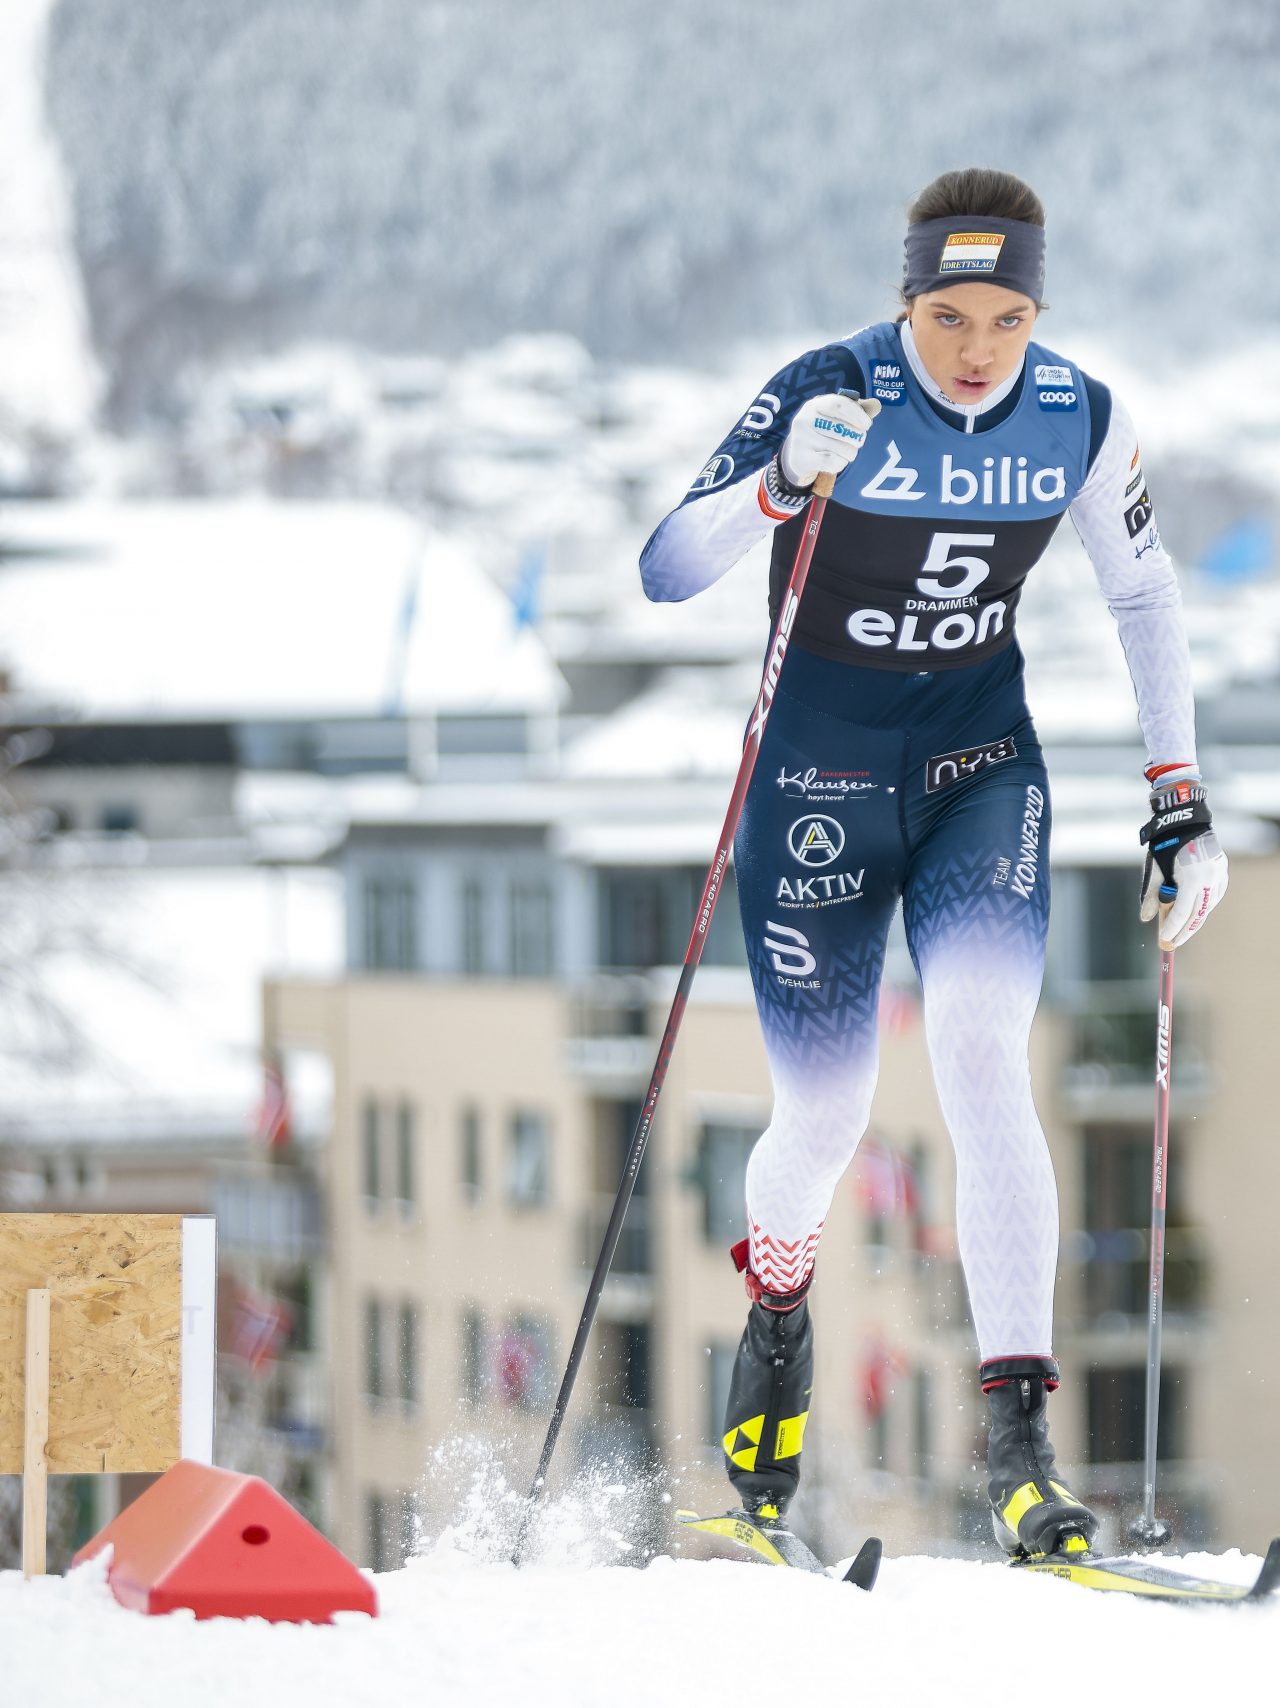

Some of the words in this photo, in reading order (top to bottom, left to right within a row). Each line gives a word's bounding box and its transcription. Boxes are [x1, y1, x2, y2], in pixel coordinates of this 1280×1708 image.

[950, 236, 999, 245] KONNERUD
[942, 259, 993, 270] IDRETTSLAG
[875, 388, 901, 400] coop
[1039, 391, 1077, 406] coop
[940, 455, 1066, 504] bilia
[916, 532, 996, 598] 5
[906, 597, 979, 612] DRAMMEN
[750, 587, 799, 747] SWIX
[777, 766, 879, 793] Klausen
[1156, 807, 1194, 830] SWIX
[1011, 785, 1044, 900] KONNERUD
[712, 849, 728, 884] TRIAC
[992, 856, 1012, 886] TEAM
[777, 868, 865, 901] AKTIV
[698, 900, 712, 933] AERO
[777, 975, 822, 988] DÆHLIE
[1156, 998, 1170, 1090] SWIX
[629, 1112, 652, 1177] TECHNOLOGY
